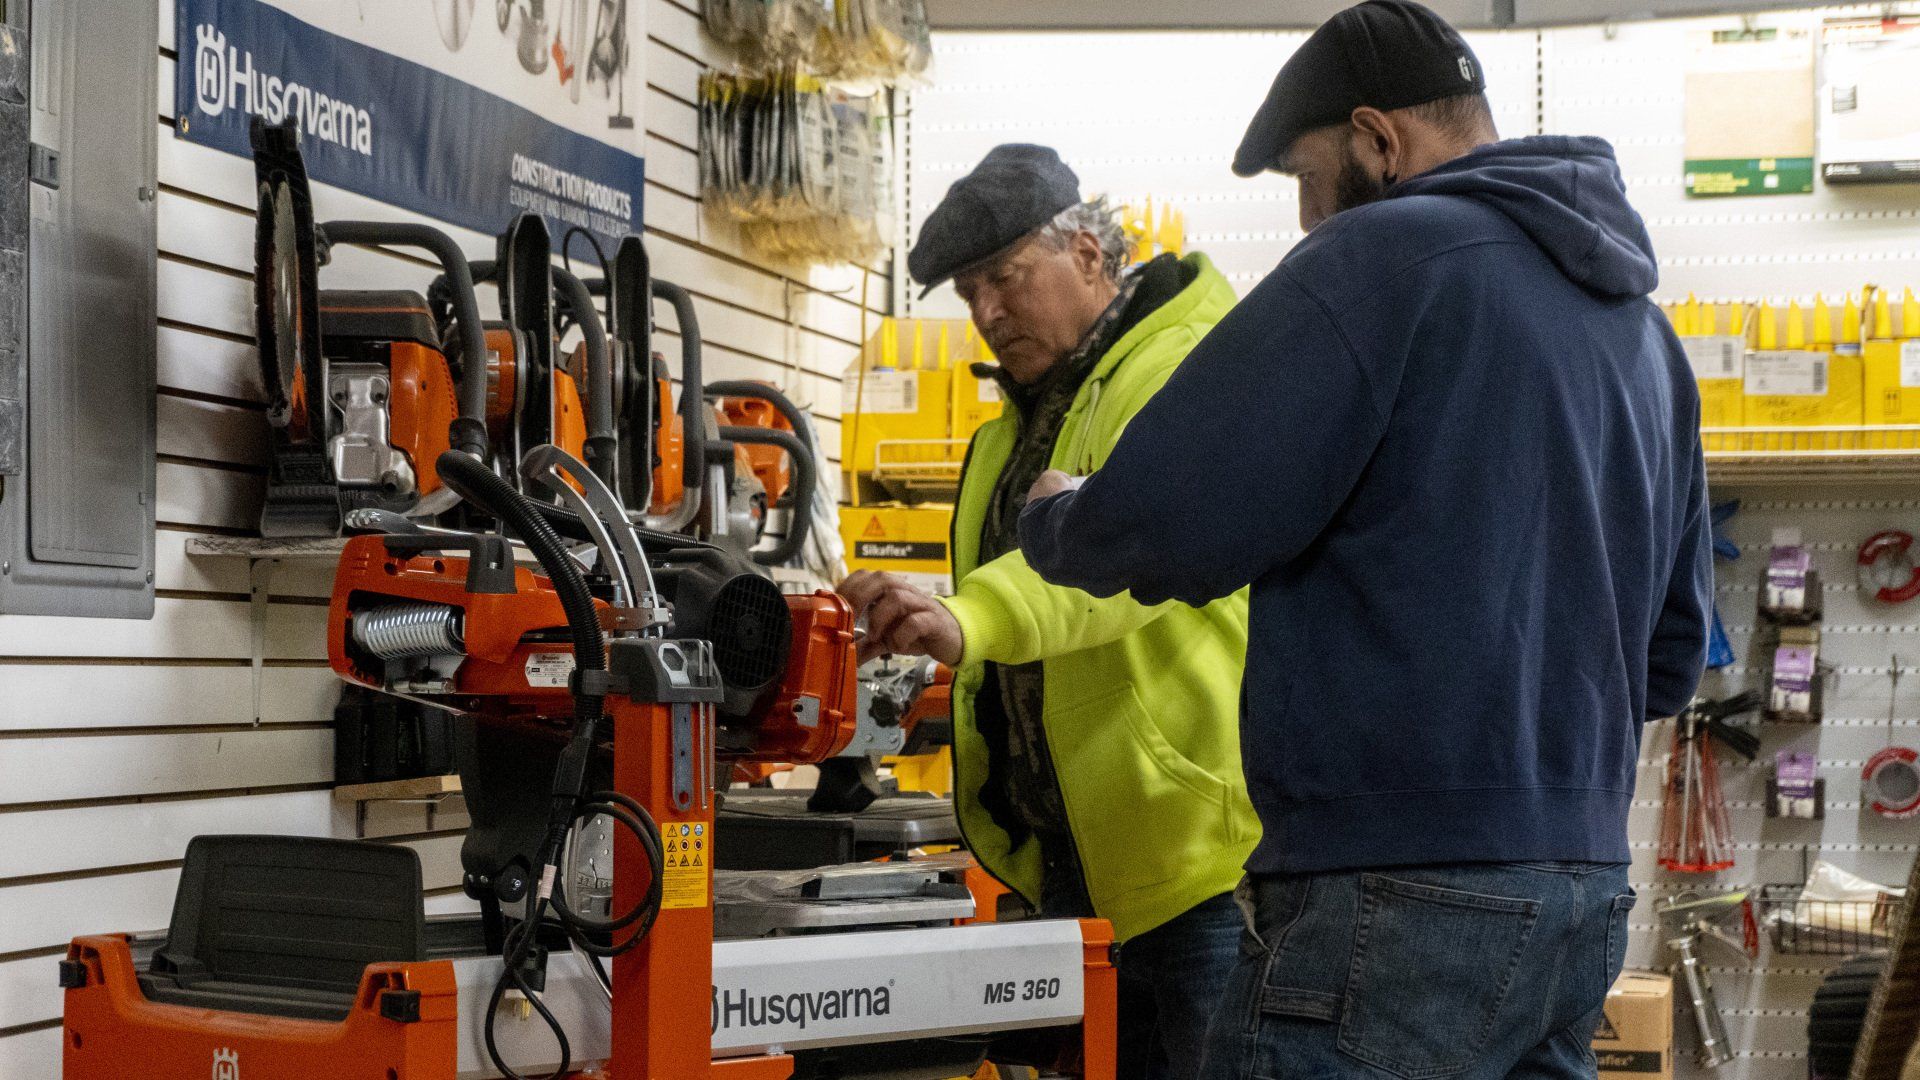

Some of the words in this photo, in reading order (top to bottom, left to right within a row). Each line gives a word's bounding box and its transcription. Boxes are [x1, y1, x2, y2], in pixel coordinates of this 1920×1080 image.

[228, 45, 372, 156] Husqvarna
[511, 152, 584, 205] CONSTRUCTION
[583, 179, 632, 220] PRODUCTS
[723, 986, 890, 1029] Husqvarna
[984, 981, 1016, 1004] MS
[1022, 977, 1060, 1001] 360
